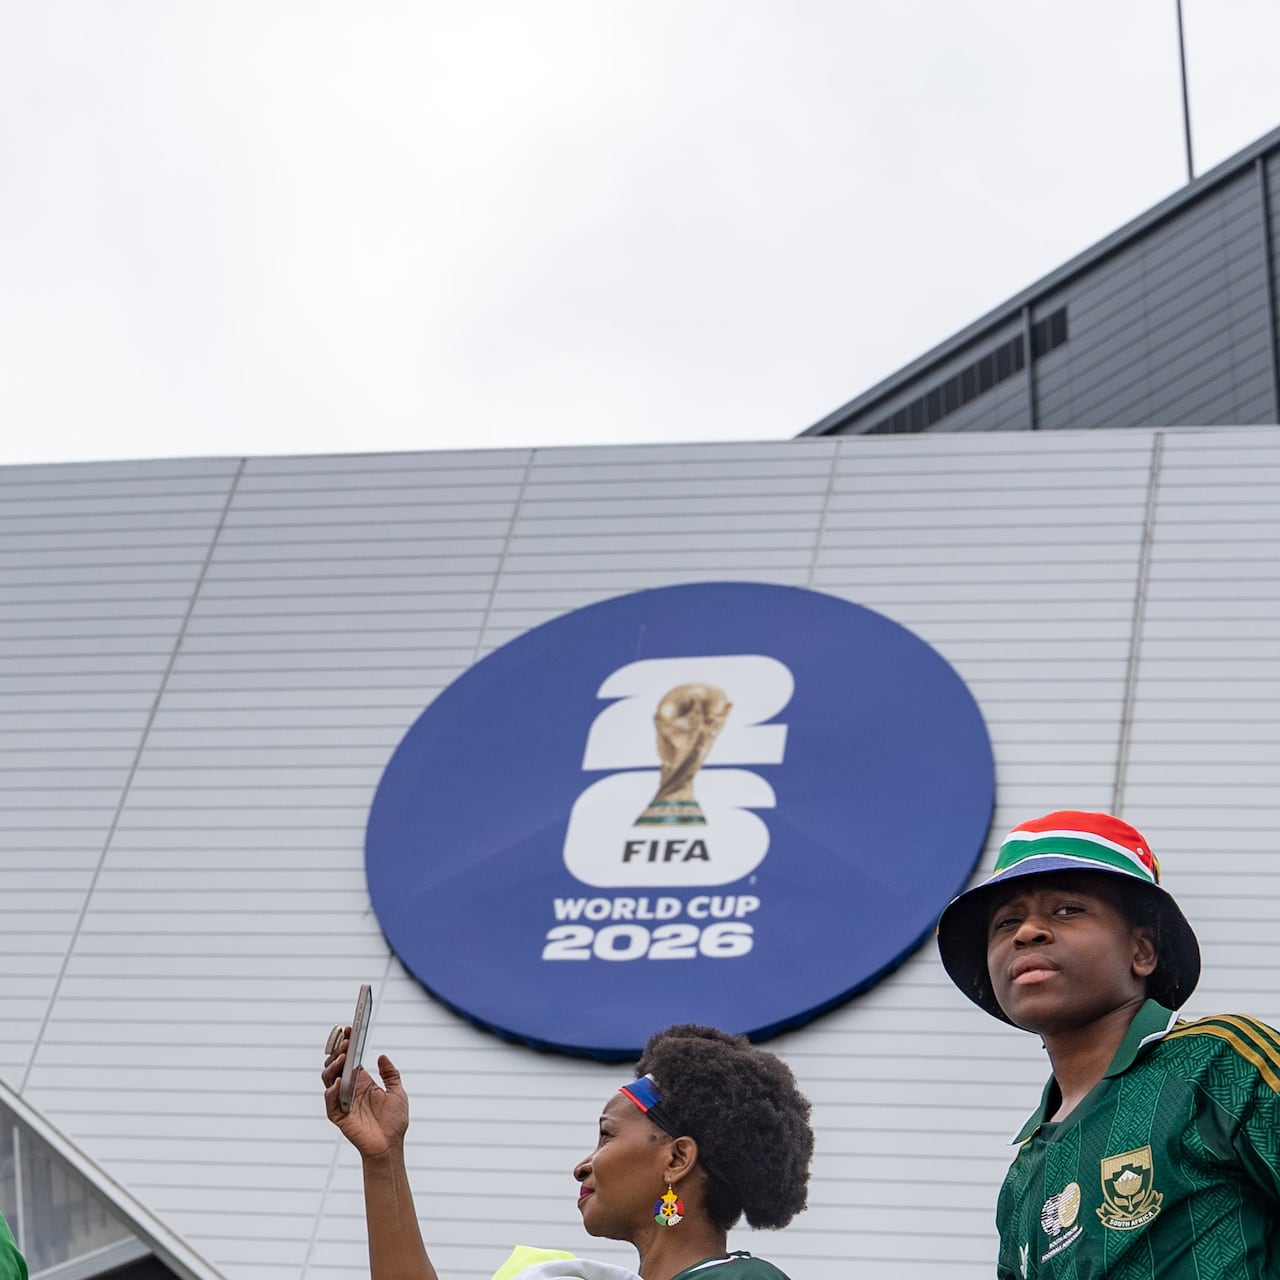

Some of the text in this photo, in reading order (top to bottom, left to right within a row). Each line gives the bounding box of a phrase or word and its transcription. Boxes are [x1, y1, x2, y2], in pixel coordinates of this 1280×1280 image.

[622, 839, 711, 863] FIFA
[552, 894, 760, 921] WORLD CUP
[541, 921, 754, 961] 2026
[1109, 1211, 1154, 1229] SOUTH AFRICA
